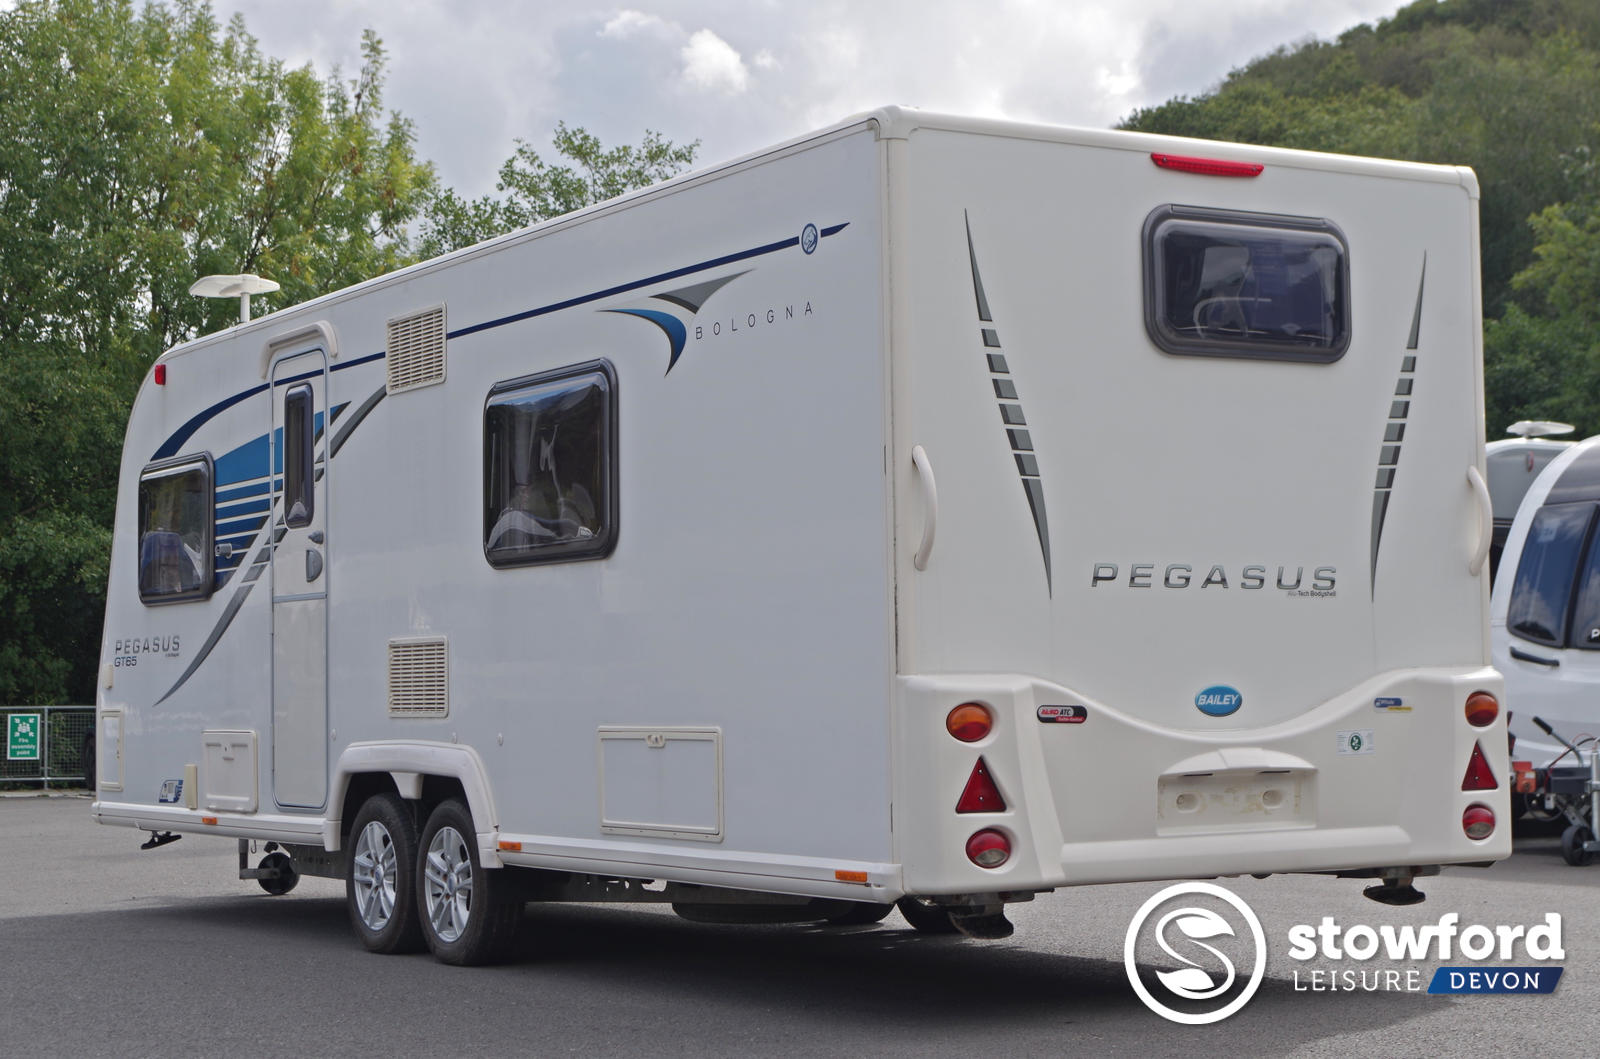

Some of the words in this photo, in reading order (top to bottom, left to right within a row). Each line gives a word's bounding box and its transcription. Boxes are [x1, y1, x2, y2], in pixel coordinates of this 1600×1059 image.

[695, 301, 812, 340] BOLOGNA
[1091, 562, 1338, 591] PEGASUS
[115, 635, 180, 655] PEGASUS
[114, 655, 138, 668] GT65
[1197, 694, 1240, 705] BAILEY
